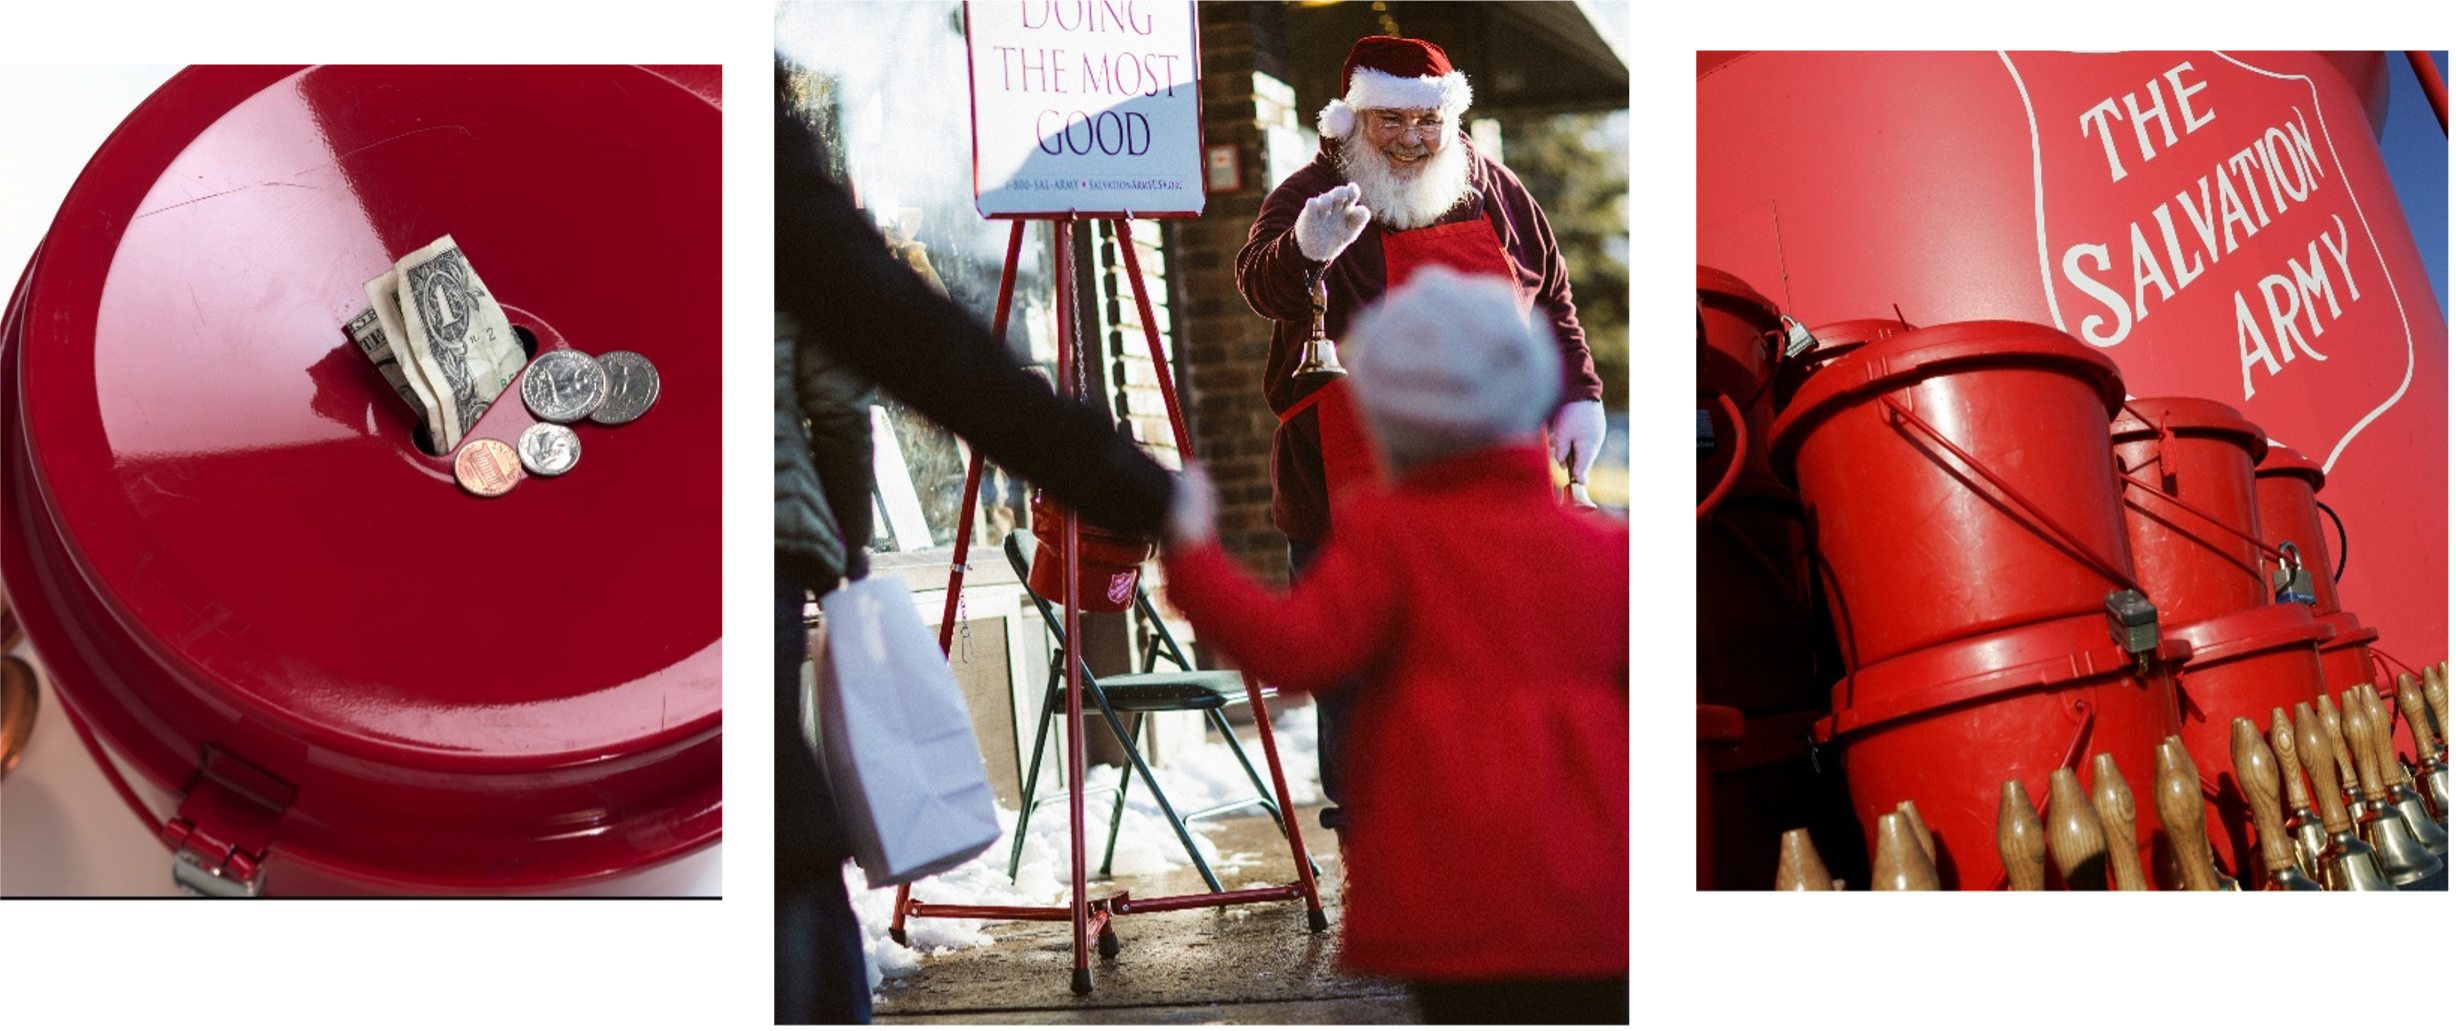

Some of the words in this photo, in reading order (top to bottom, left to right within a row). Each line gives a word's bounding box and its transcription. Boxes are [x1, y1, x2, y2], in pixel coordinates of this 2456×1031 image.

[1021, 0, 1152, 35] DOING
[993, 46, 1068, 94] THE
[1082, 51, 1179, 98] MOST
[1036, 109, 1151, 156] GOOD
[2079, 60, 2216, 183] THE
[2062, 106, 2325, 348] SALVATION
[2233, 214, 2361, 401] ARMY
